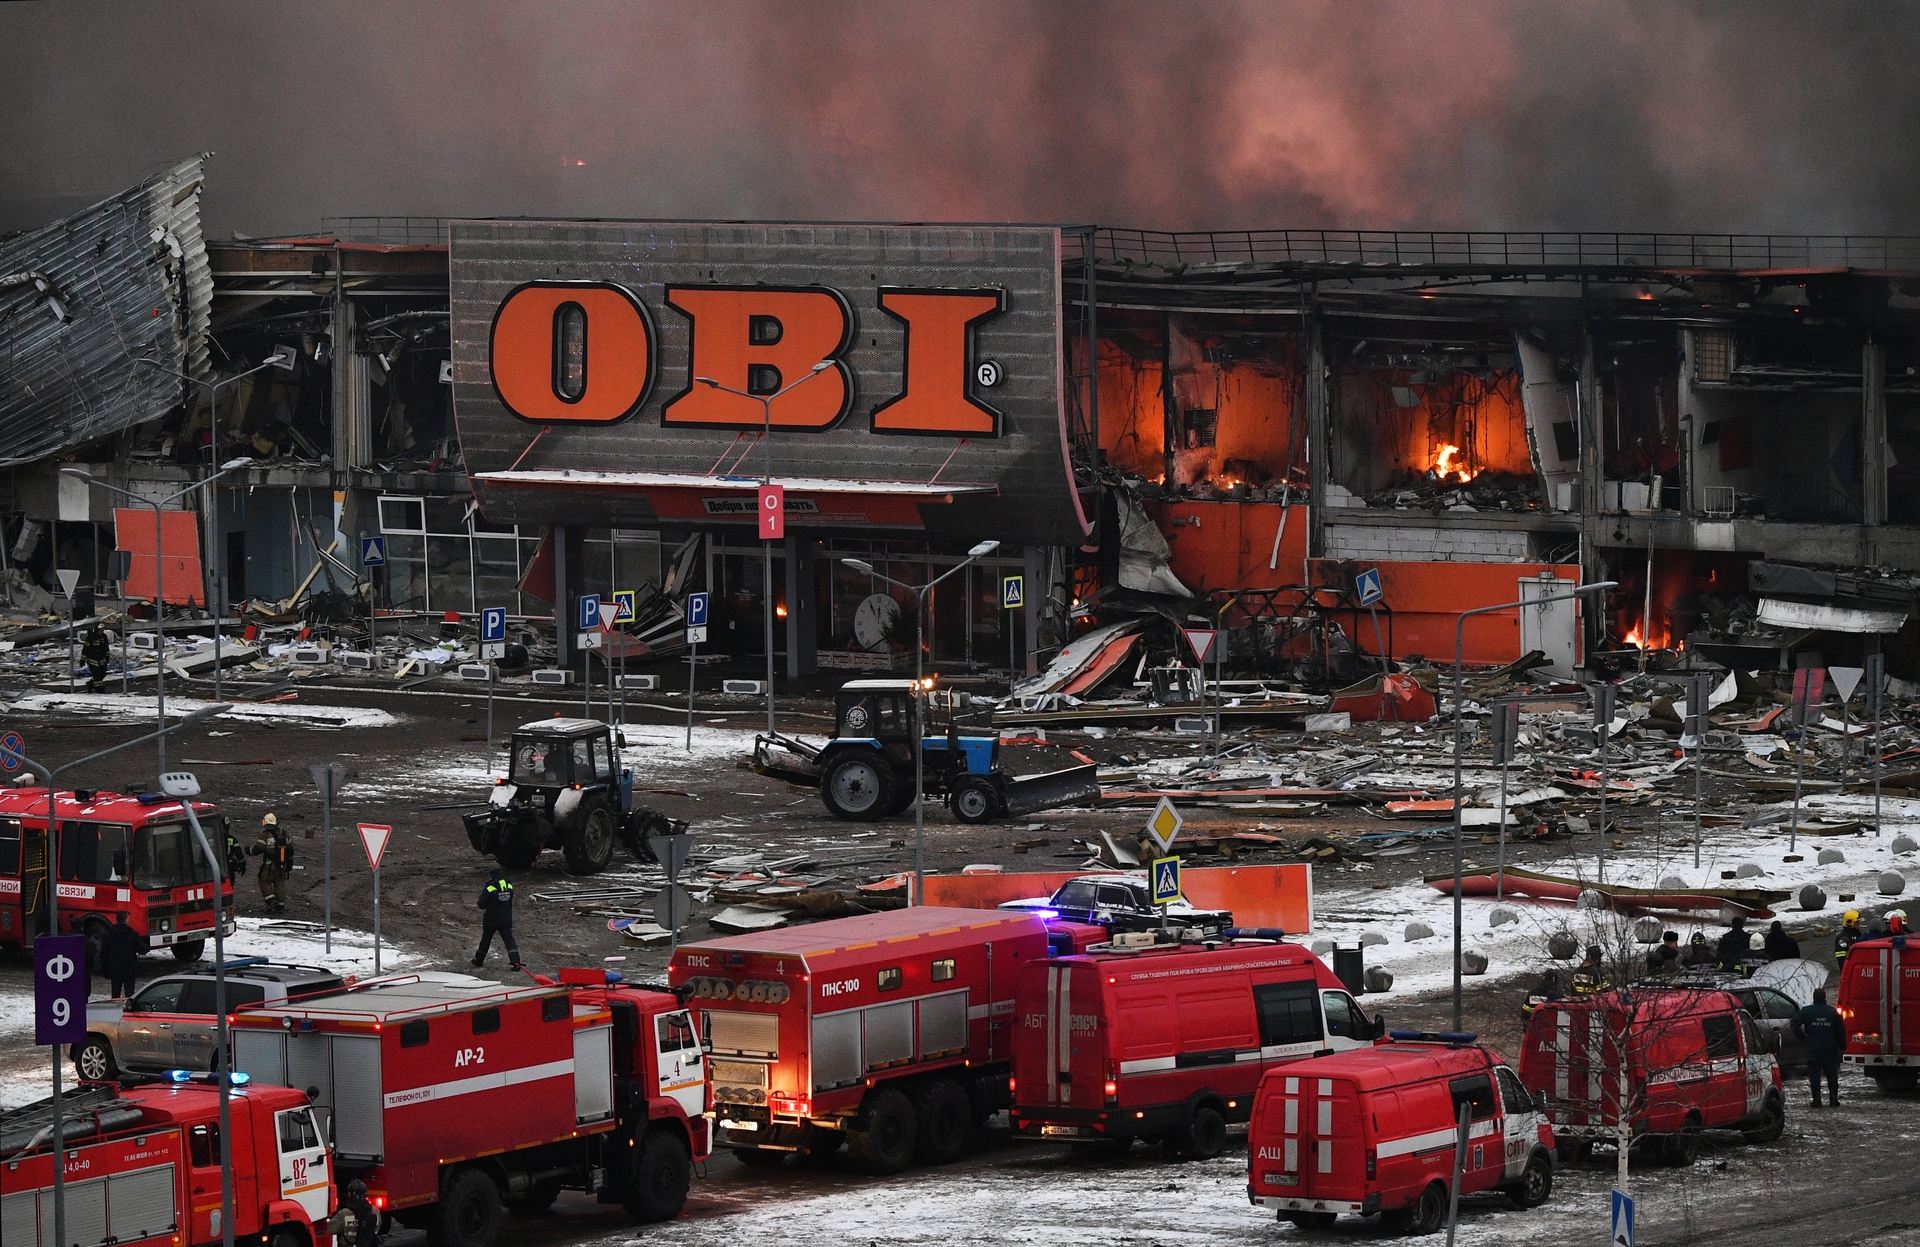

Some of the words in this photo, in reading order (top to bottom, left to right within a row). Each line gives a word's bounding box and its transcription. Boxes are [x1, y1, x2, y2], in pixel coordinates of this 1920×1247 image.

[489, 280, 1008, 438] OBI
[707, 500, 740, 513] Добро
[768, 515, 775, 530] 1
[585, 599, 596, 624] P
[692, 597, 703, 622] P
[487, 613, 500, 637] P
[58, 886, 87, 897] СВЯЗИ
[46, 954, 75, 982] Ф
[687, 955, 710, 968] ПНС
[776, 960, 785, 975] 4
[1861, 968, 1874, 978] АШ
[821, 978, 860, 997] ПНС-100
[52, 998, 71, 1026] 9
[995, 1002, 1015, 1012] ТЕЛЕФО
[1024, 1014, 1047, 1028] АБГ
[454, 1046, 485, 1068] АР-2
[674, 1060, 681, 1077] 4
[388, 1094, 414, 1104] ТЕЛЕФОН
[1257, 1146, 1281, 1160] АШ
[1506, 1138, 1526, 1158] СПТ
[124, 1152, 148, 1162] ТЕЛЕФОН
[68, 1159, 90, 1173] 4,0-40
[293, 1157, 308, 1180] 82
